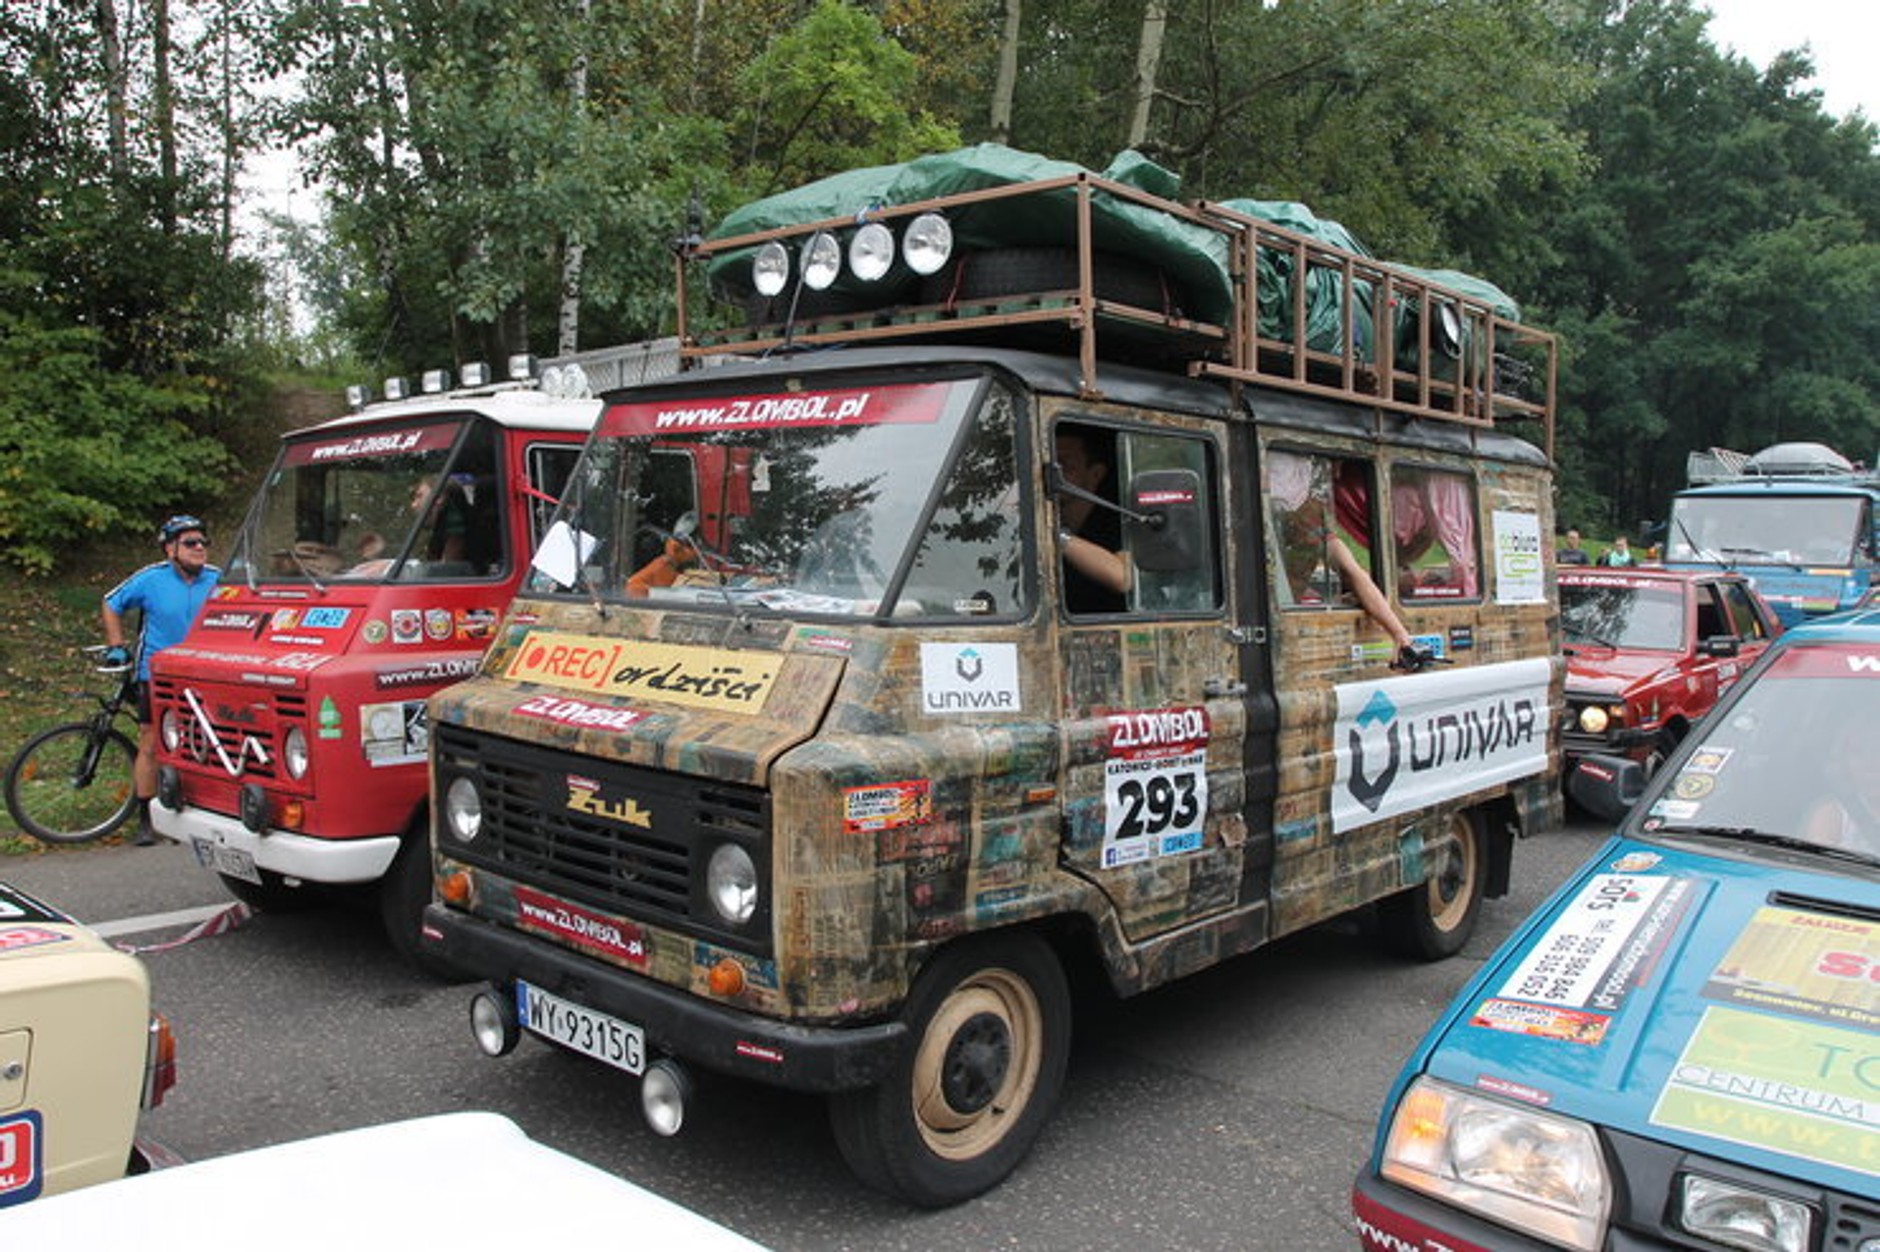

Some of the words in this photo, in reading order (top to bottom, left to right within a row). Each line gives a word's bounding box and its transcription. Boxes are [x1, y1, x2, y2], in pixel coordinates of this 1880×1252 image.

[655, 394, 869, 427] www.ZLOMBOL.pl
[520, 696, 641, 729] ZLOMBOL
[927, 689, 1014, 709] UNIVAR
[1108, 708, 1209, 749] ZLOMBOL
[1407, 699, 1537, 773] UNIVAR
[1115, 771, 1199, 840] 293
[521, 902, 643, 957] www.ZLOMBOL.pl
[530, 992, 556, 1036] WY
[566, 1009, 640, 1069] 9315G
[1677, 1065, 1864, 1118] CENTRUM
